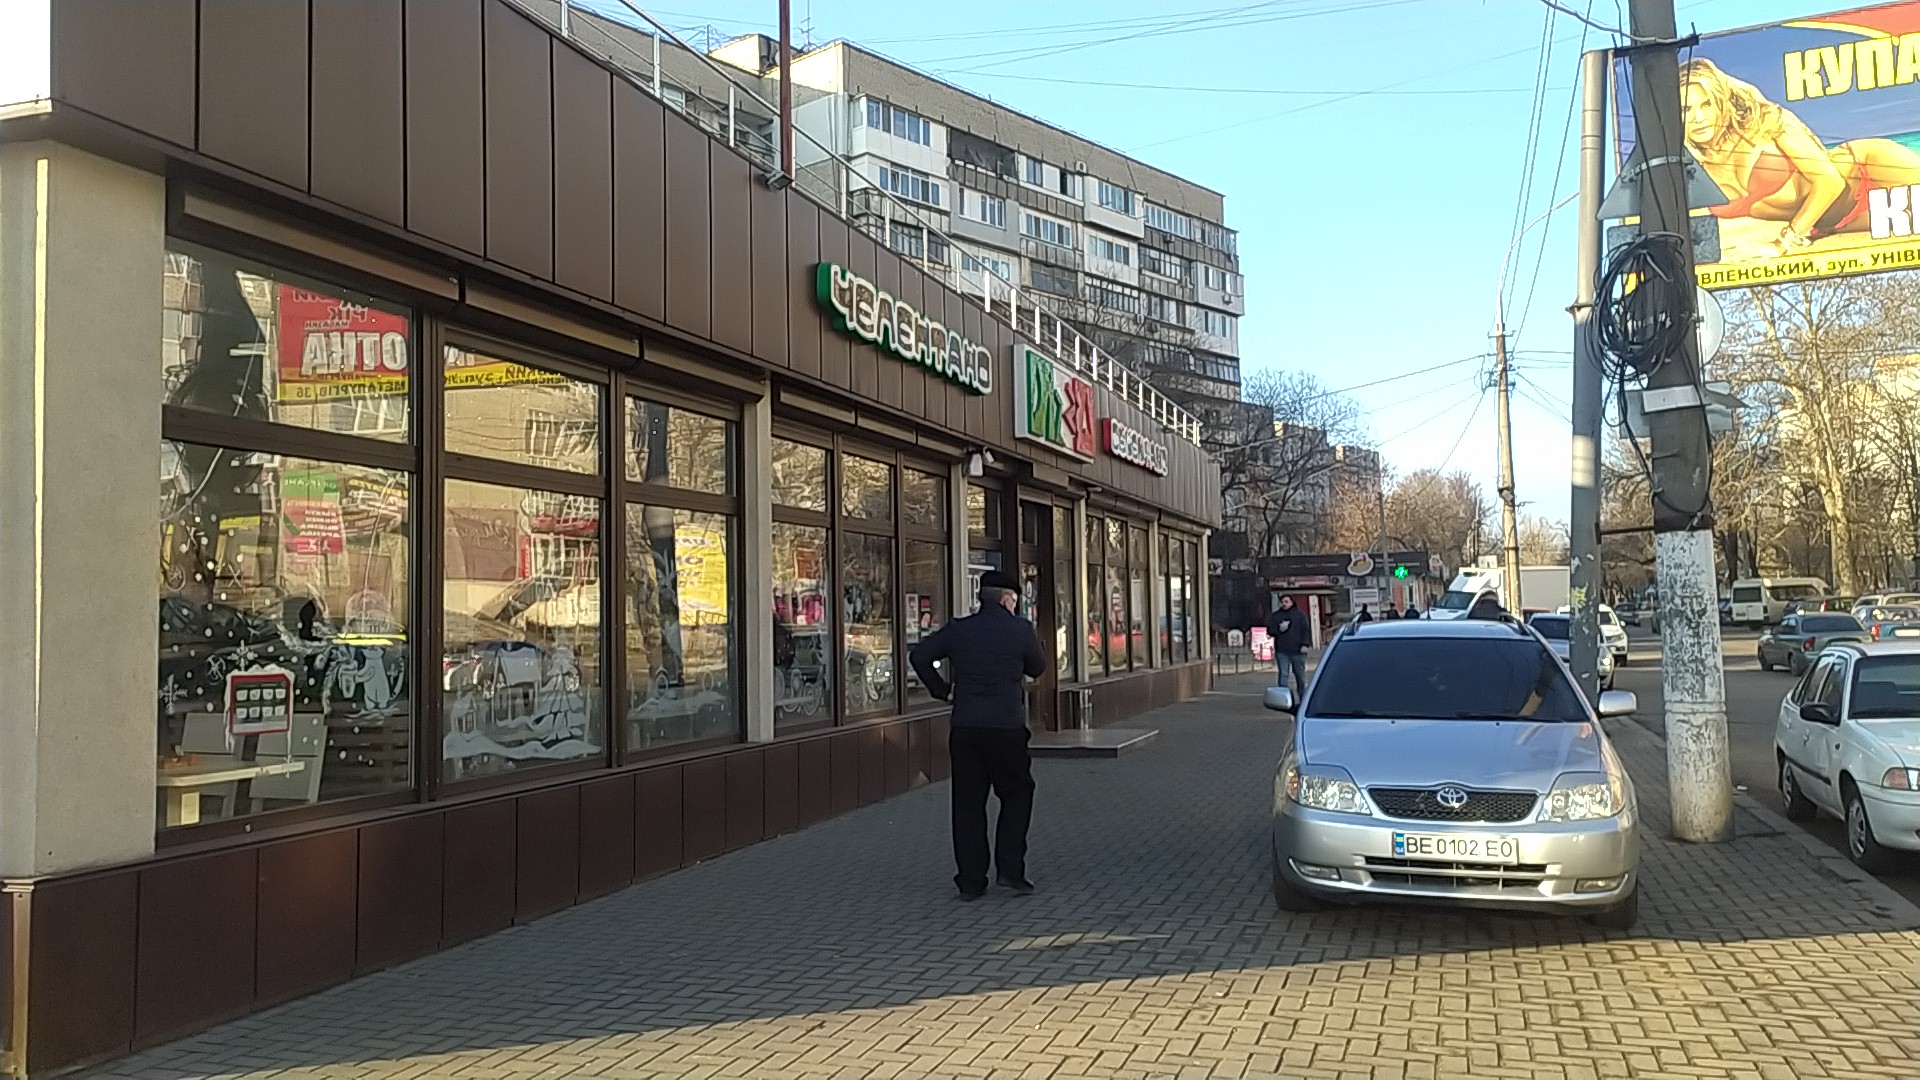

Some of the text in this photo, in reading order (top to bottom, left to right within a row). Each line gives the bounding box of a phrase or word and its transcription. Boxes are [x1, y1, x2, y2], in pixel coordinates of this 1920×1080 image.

[829, 263, 994, 396] ЧЕЛЕНТАНО
[1406, 836, 1433, 855] BE
[1436, 838, 1479, 856] 0102
